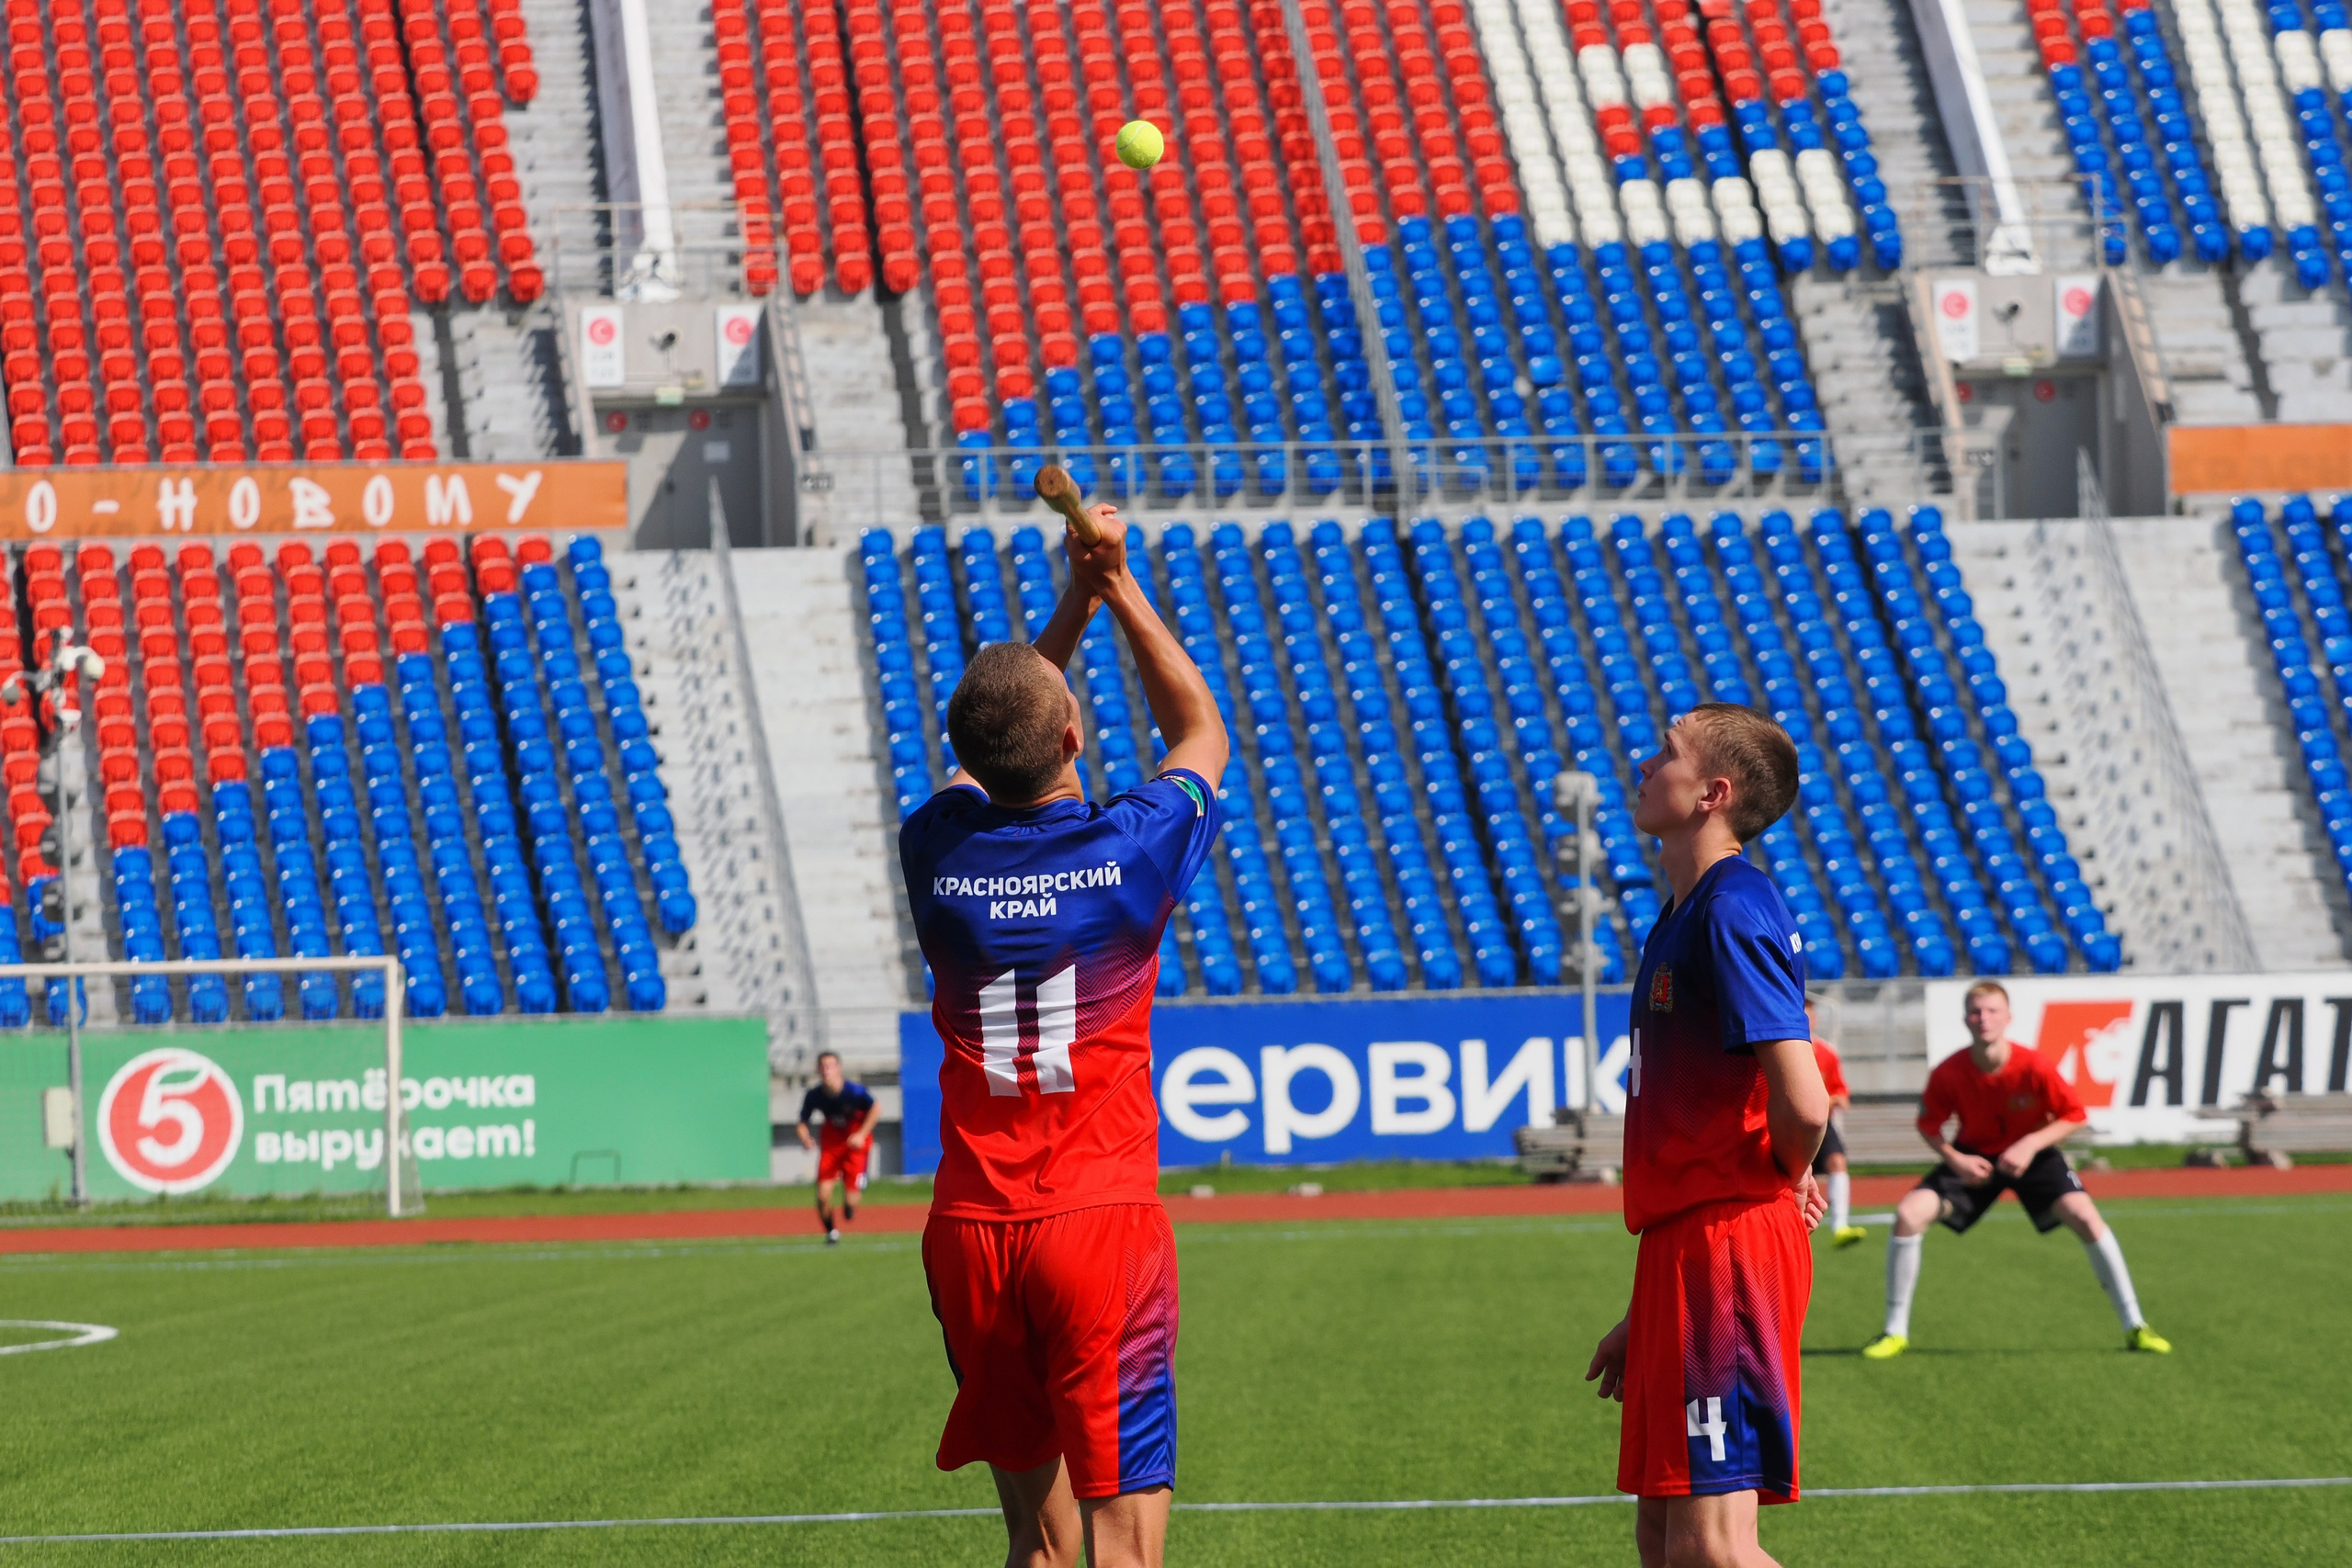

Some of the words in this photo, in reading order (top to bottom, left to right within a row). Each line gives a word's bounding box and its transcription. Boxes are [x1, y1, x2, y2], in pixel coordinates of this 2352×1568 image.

[933, 861, 1122, 897] КРАСНОЯРСКИЙ
[989, 893, 1057, 919] КРАЙ
[978, 964, 1076, 1097] 11
[254, 1067, 536, 1118] Пятёрочка
[1149, 1035, 1630, 1155] ервик
[1686, 1396, 1727, 1461] 4
